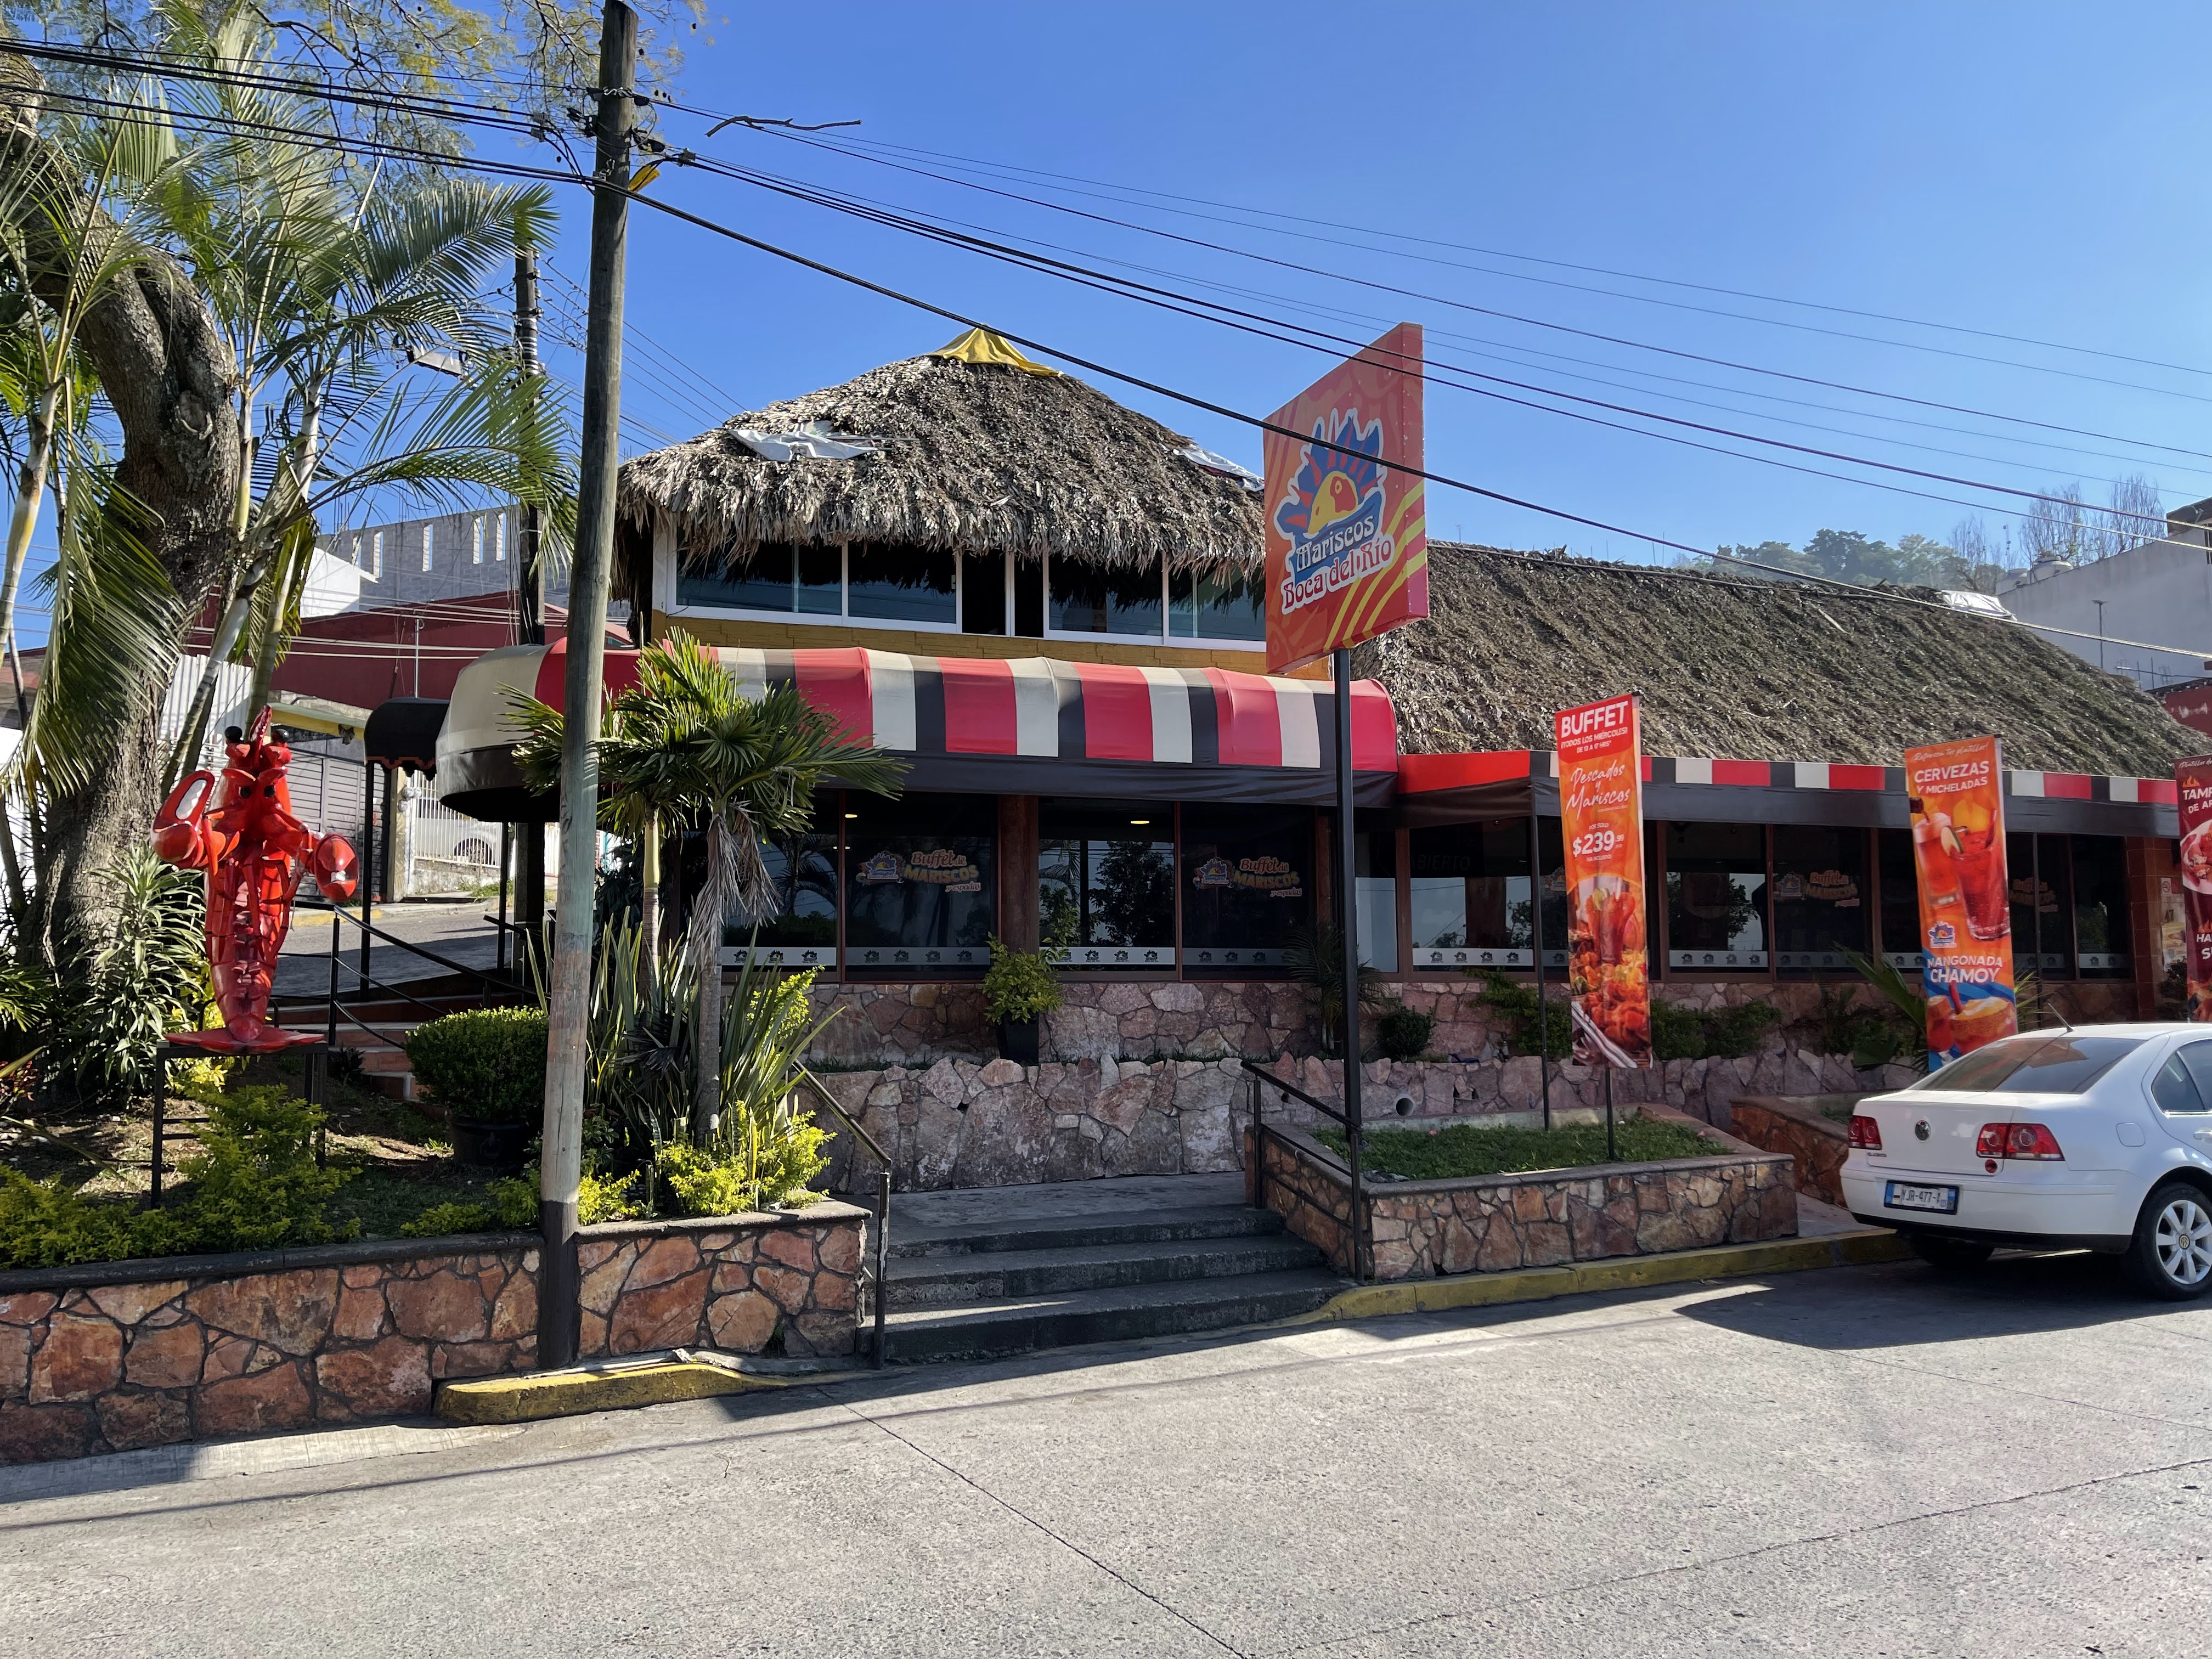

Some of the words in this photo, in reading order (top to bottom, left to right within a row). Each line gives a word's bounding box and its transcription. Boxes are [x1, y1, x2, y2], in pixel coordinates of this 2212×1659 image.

[1296, 515, 1374, 573] Mariscos
[1283, 574, 1324, 610] Boca
[1329, 550, 1355, 586] del
[1360, 538, 1392, 572] Río
[1561, 701, 1629, 738] BUFFET
[1582, 735, 1593, 744] LOS
[1571, 759, 1626, 793] Pescados
[1914, 760, 1989, 783] CERVEZAS
[1595, 781, 1601, 793] y
[1916, 786, 1925, 794] Y
[1926, 776, 1988, 794] MICHELADAS
[1565, 786, 1631, 821] Mariscos
[2188, 803, 2199, 814] DE
[913, 849, 955, 868] Buffet
[955, 855, 966, 865] de
[1240, 857, 1279, 874] Buffet
[904, 865, 979, 884] MARISCOS
[1233, 870, 1301, 889] MARISCOS
[2196, 934, 2212, 943] HA
[1931, 968, 2000, 983] CHAMOY
